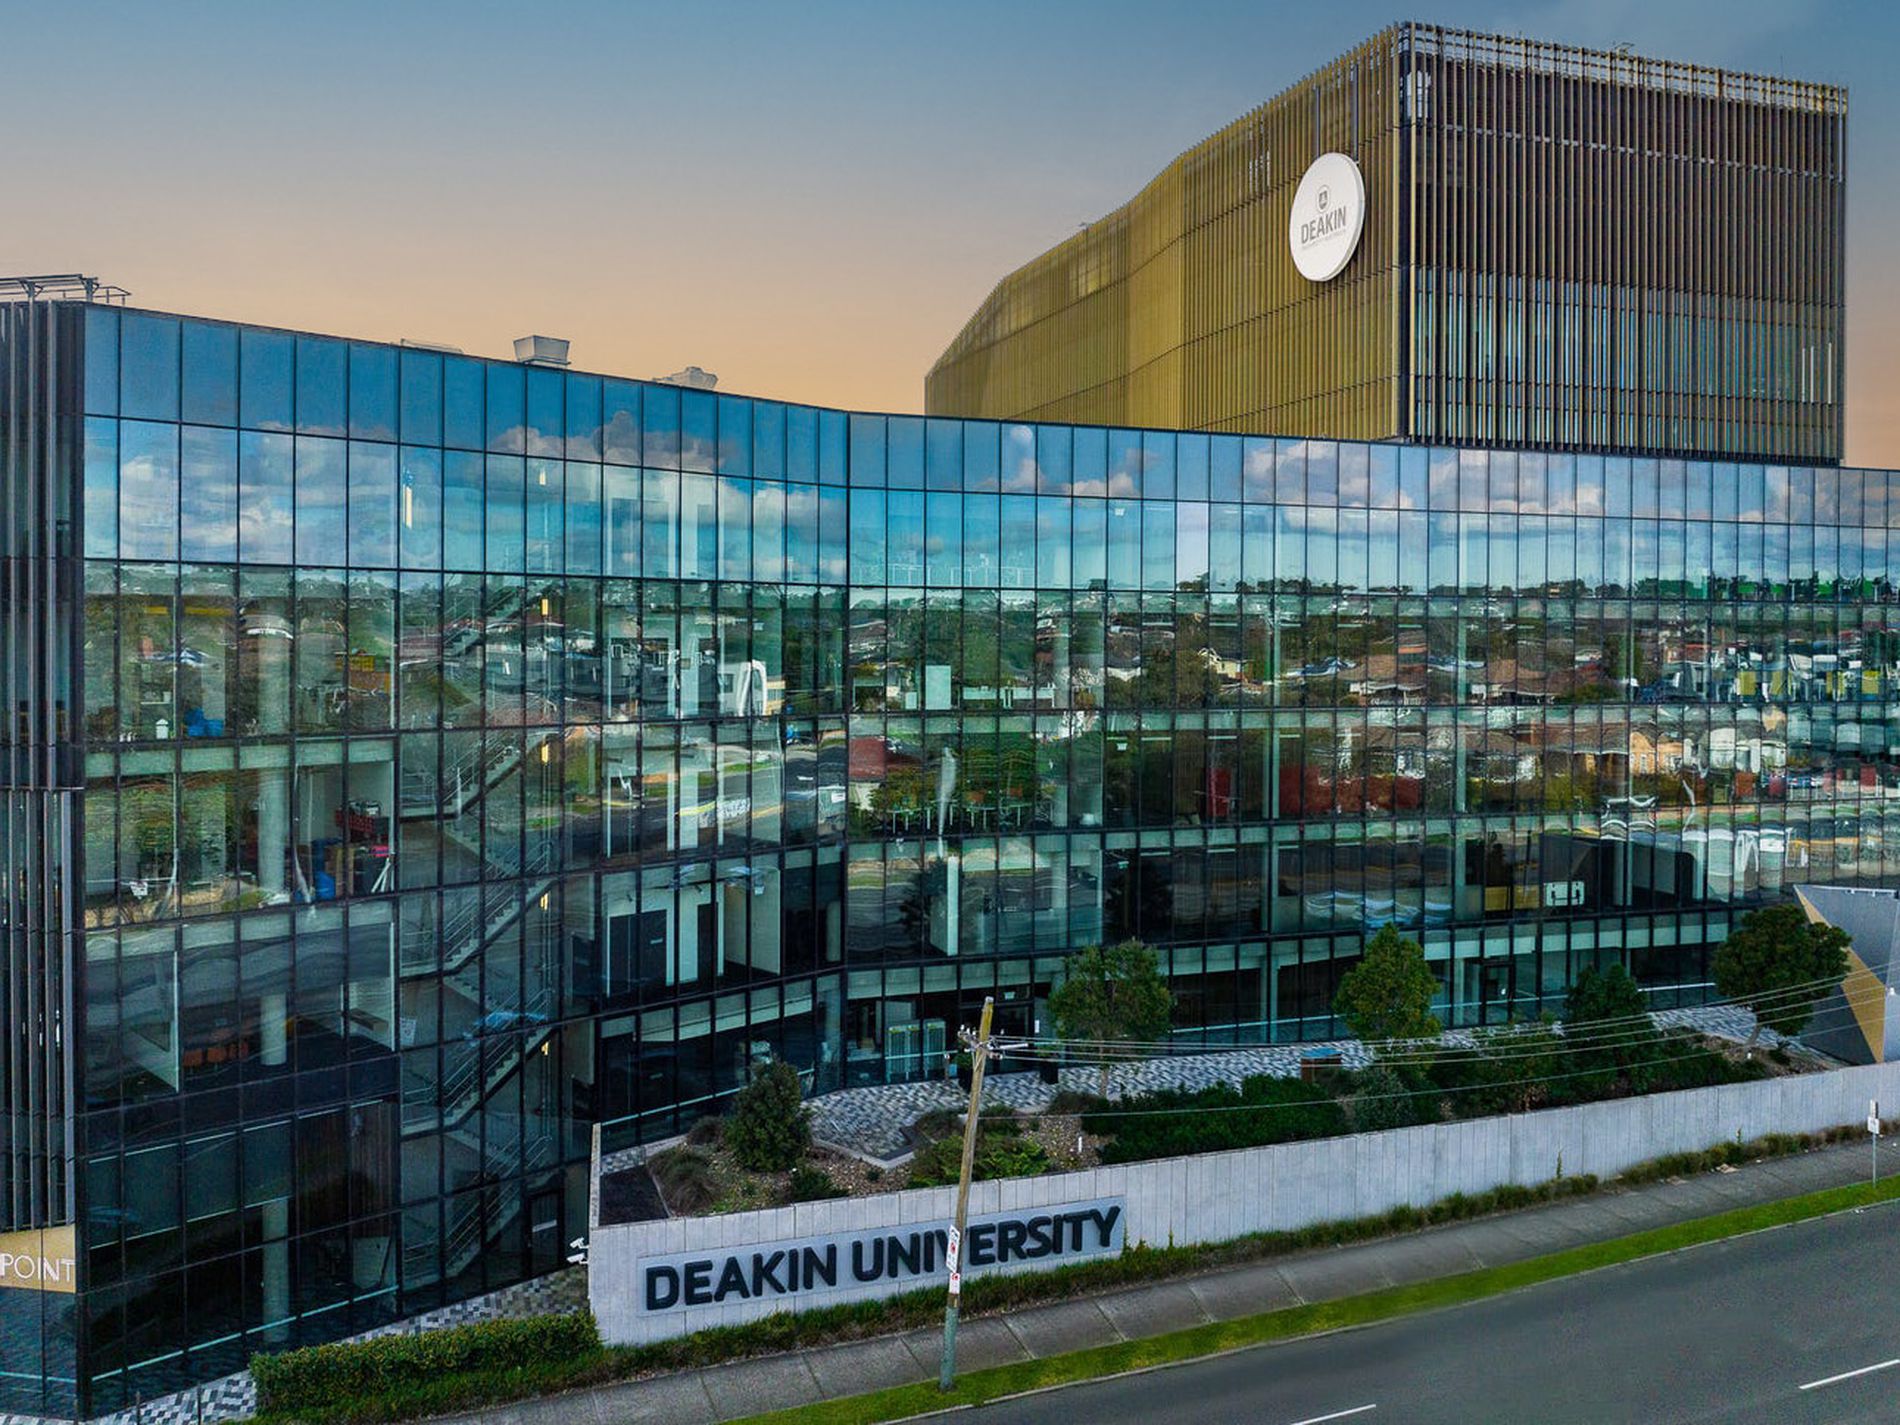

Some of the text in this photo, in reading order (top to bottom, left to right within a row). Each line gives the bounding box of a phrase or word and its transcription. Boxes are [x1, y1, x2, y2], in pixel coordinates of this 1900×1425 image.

[1301, 207, 1346, 244] DEAKIN
[0, 1253, 75, 1282] POINT
[645, 1244, 837, 1310] DEAKIN
